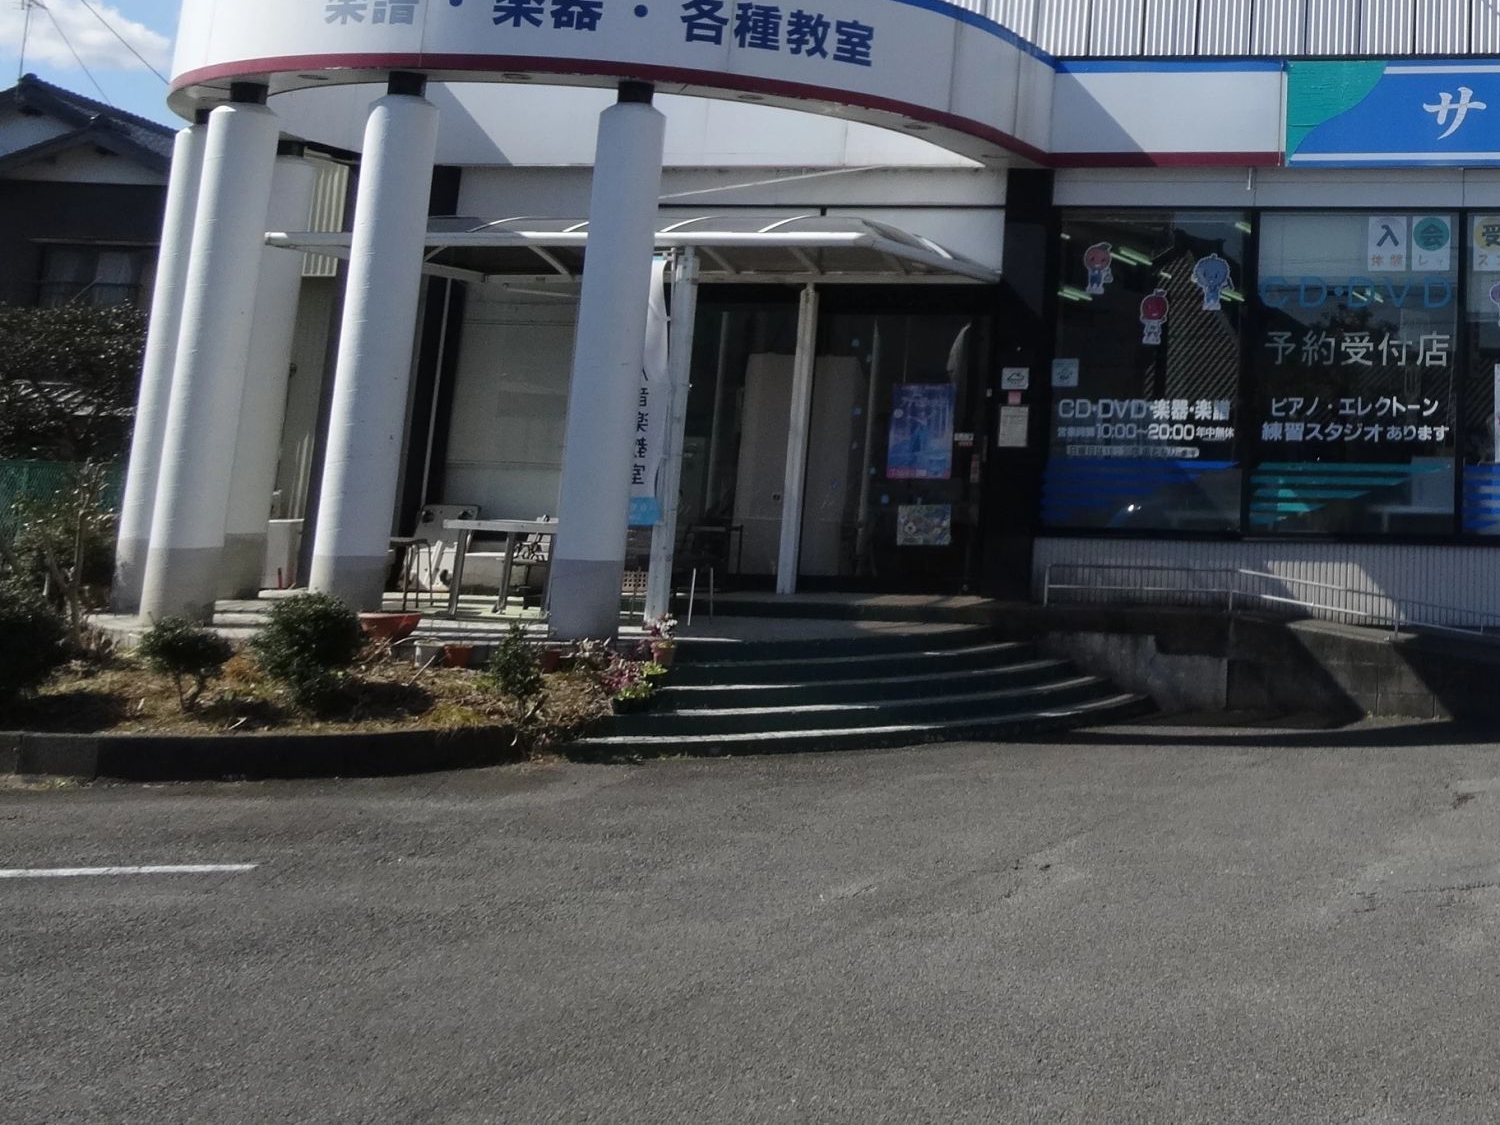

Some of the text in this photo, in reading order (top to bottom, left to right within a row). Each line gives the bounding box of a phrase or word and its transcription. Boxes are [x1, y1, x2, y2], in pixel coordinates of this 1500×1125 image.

[1264, 329, 1450, 367] 予約受付店
